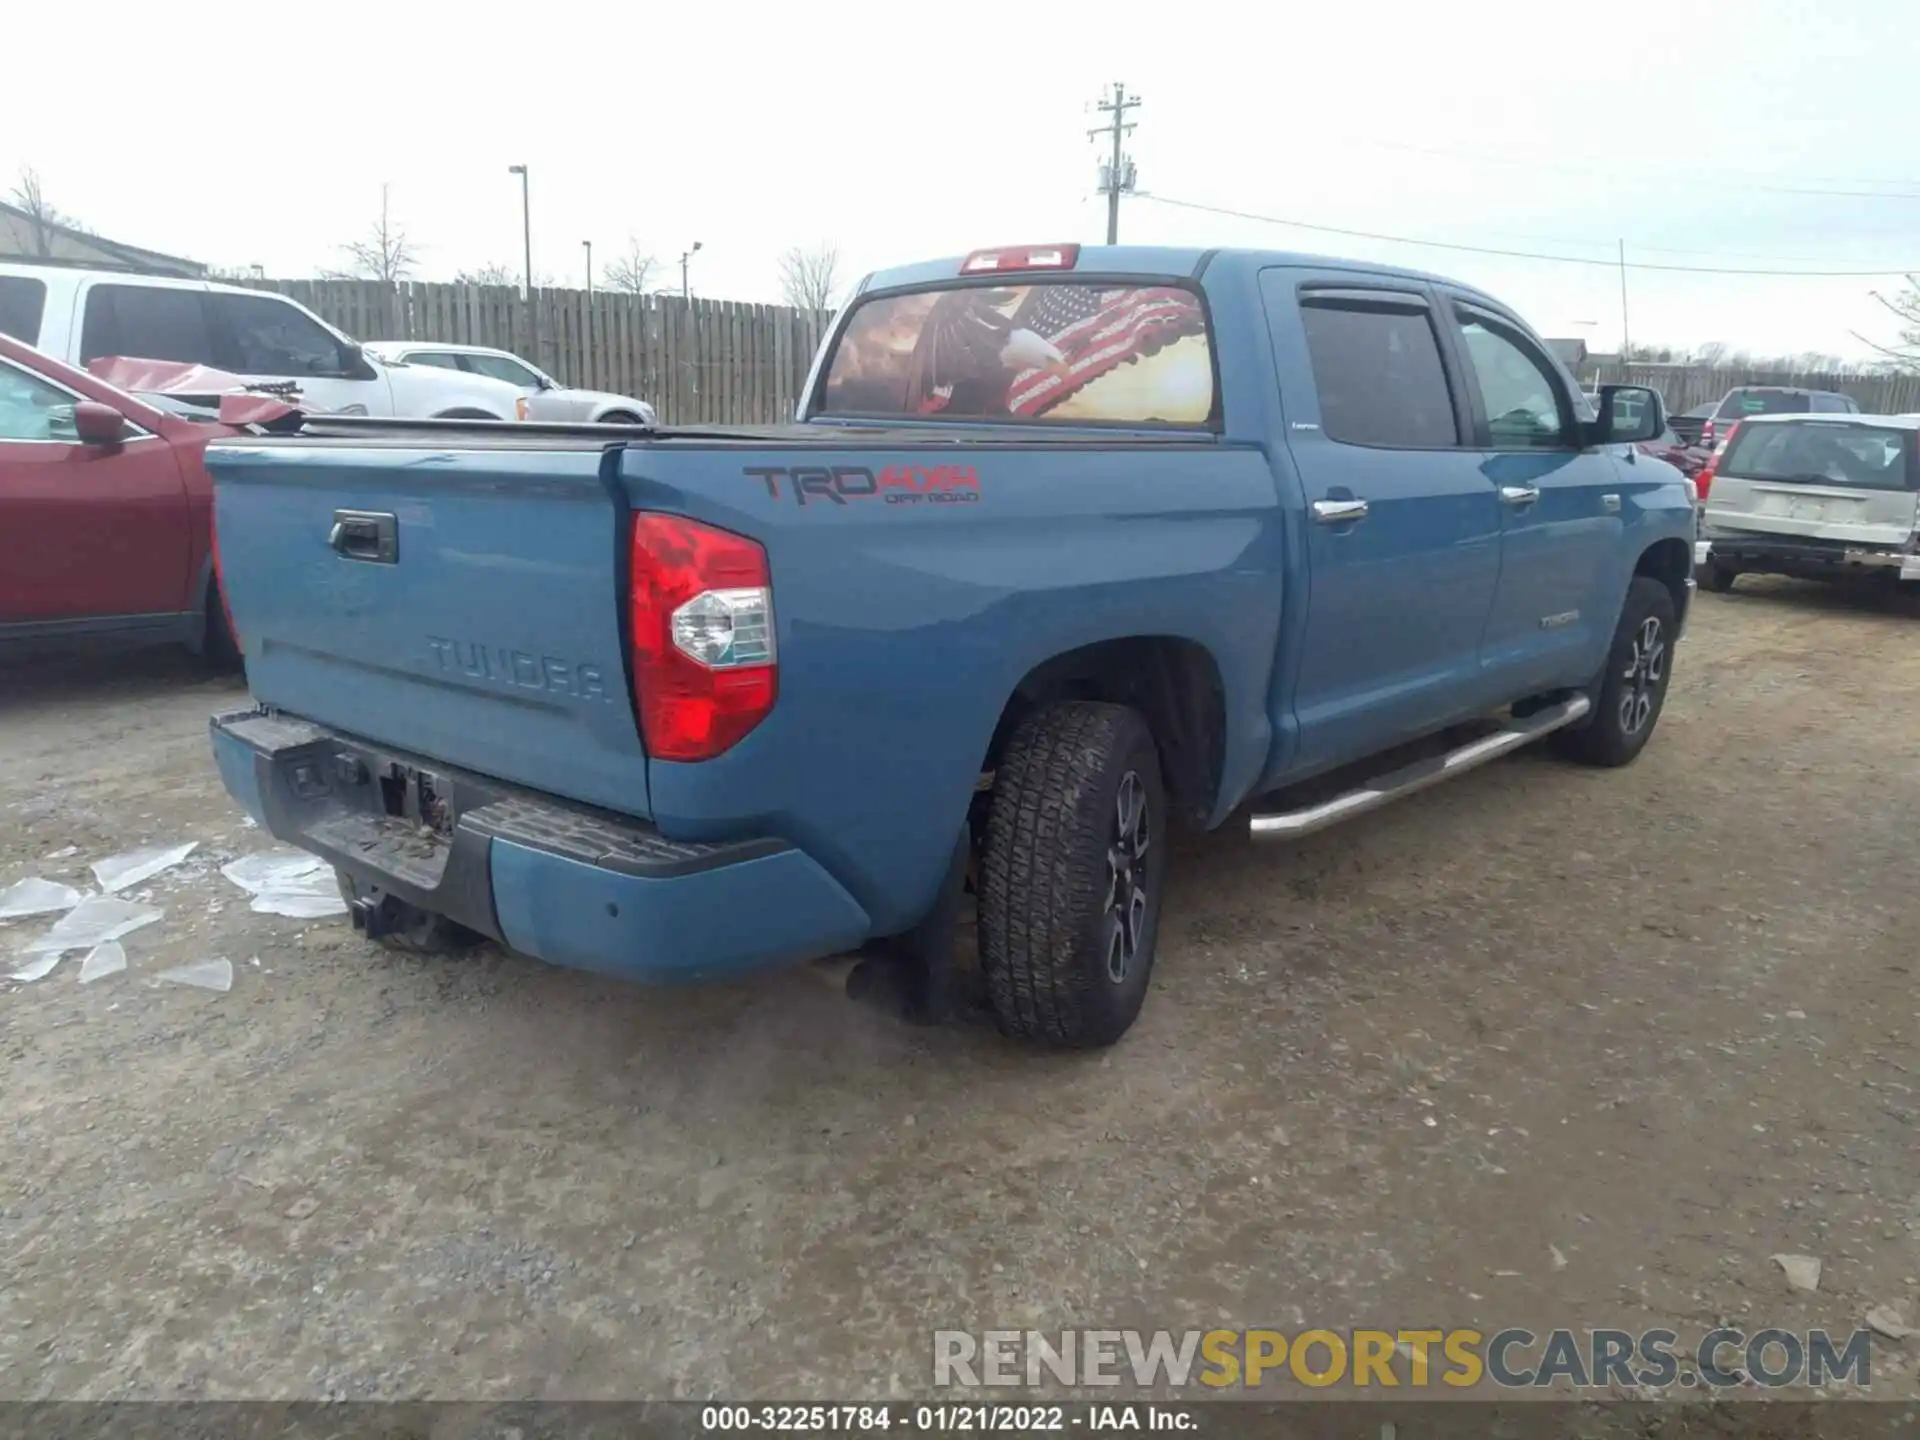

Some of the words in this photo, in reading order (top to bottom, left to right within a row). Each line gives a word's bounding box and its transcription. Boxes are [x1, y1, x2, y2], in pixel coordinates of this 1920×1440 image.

[742, 466, 878, 506] TRD
[884, 493, 920, 505] OFF
[927, 491, 979, 503] ROAD
[424, 634, 613, 704] TUNDRA
